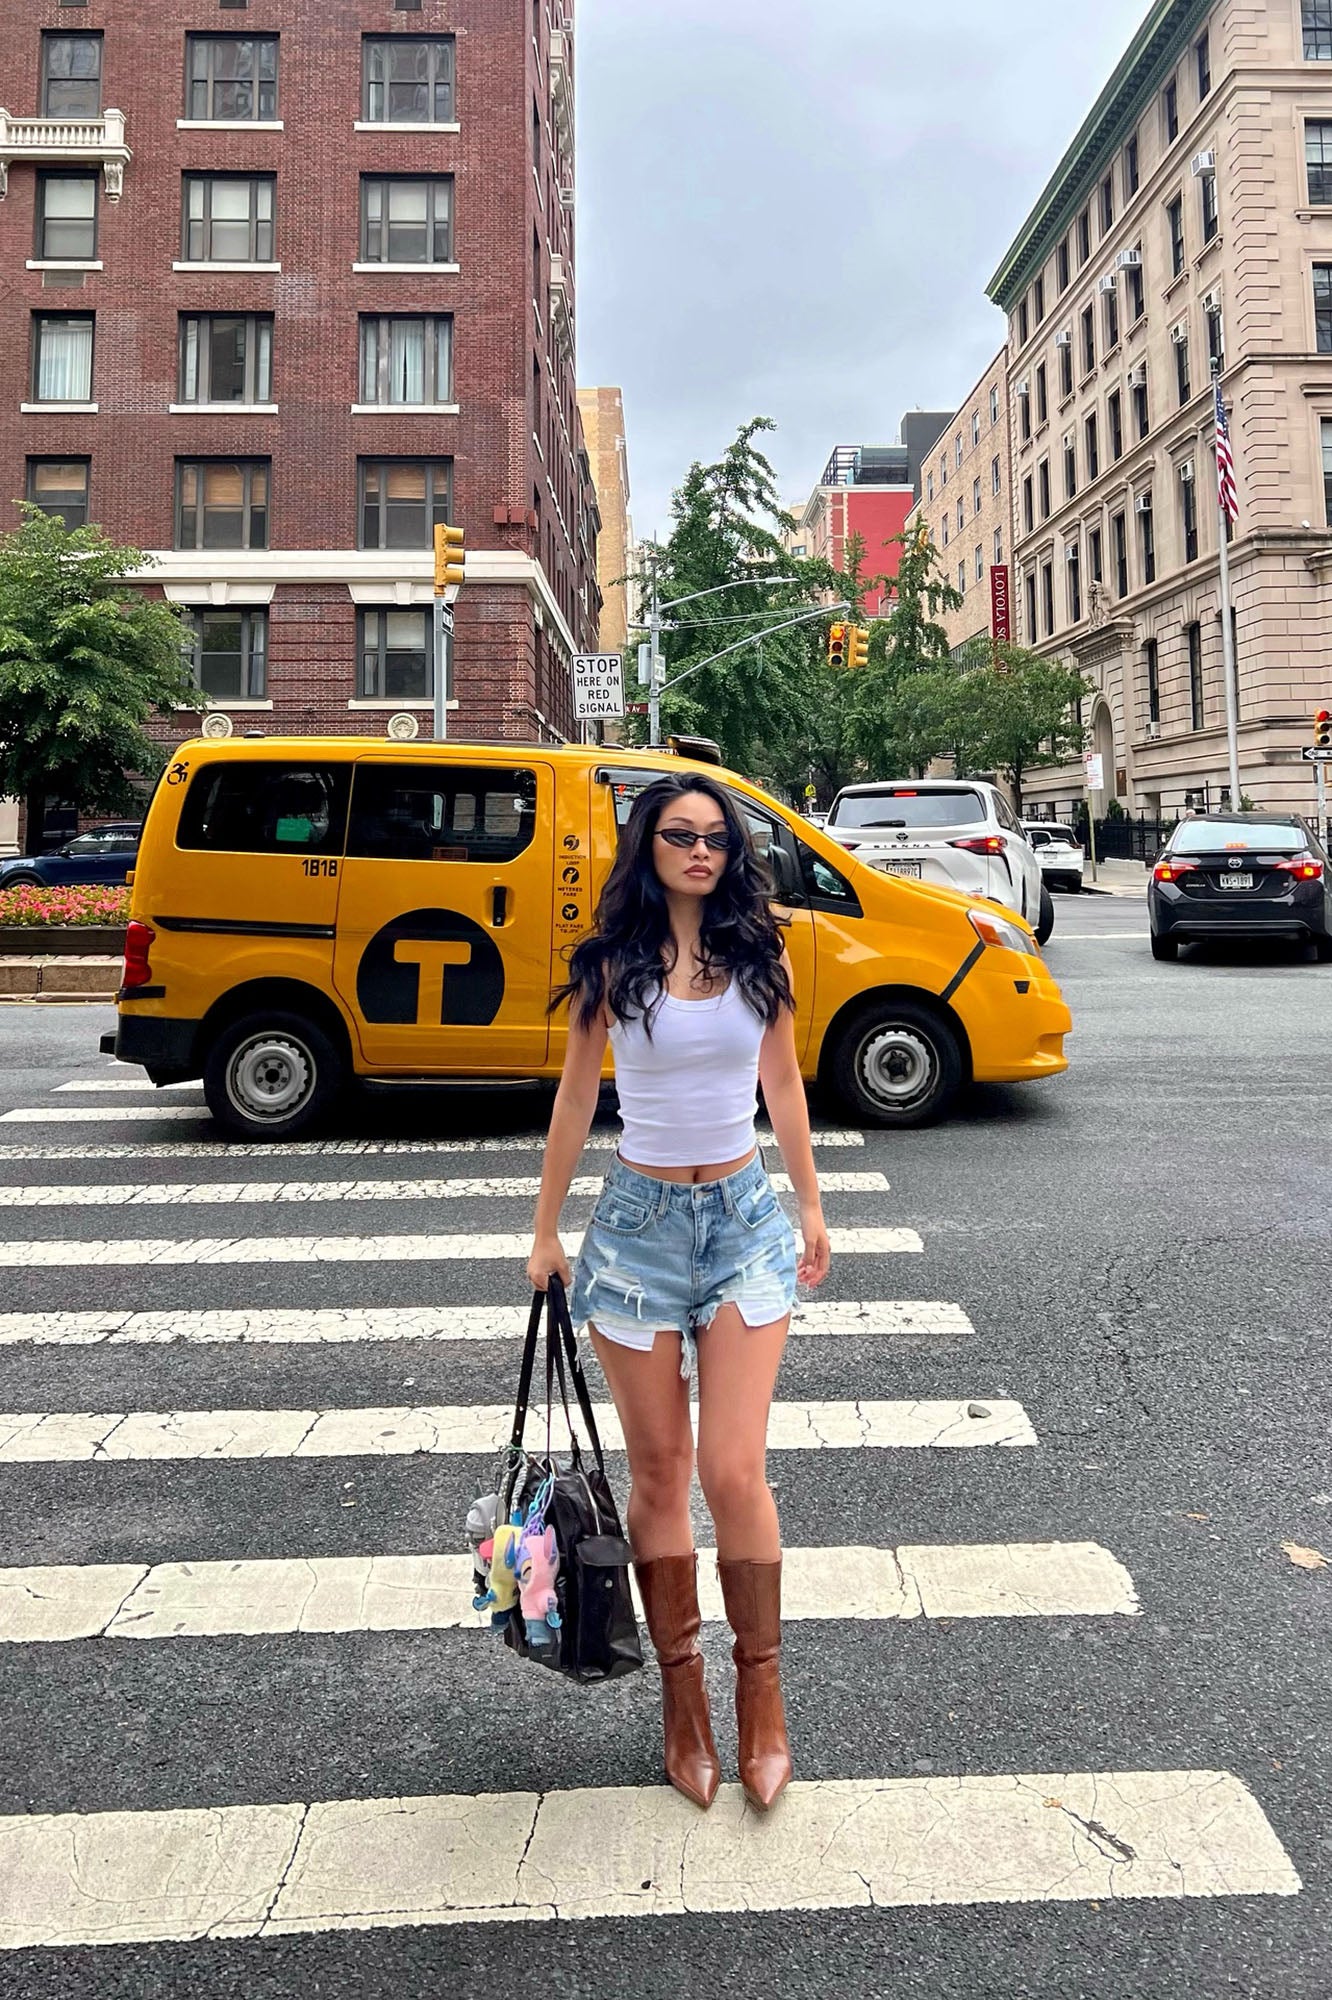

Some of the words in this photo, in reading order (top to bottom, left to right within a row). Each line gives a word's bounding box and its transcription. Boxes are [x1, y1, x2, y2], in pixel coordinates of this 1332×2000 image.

[994, 572, 1006, 622] LOYOLA
[576, 659, 619, 674] STOP
[577, 676, 601, 687] HERE
[606, 676, 620, 686] ON
[588, 689, 610, 700] RED
[579, 703, 621, 713] SIGNAL
